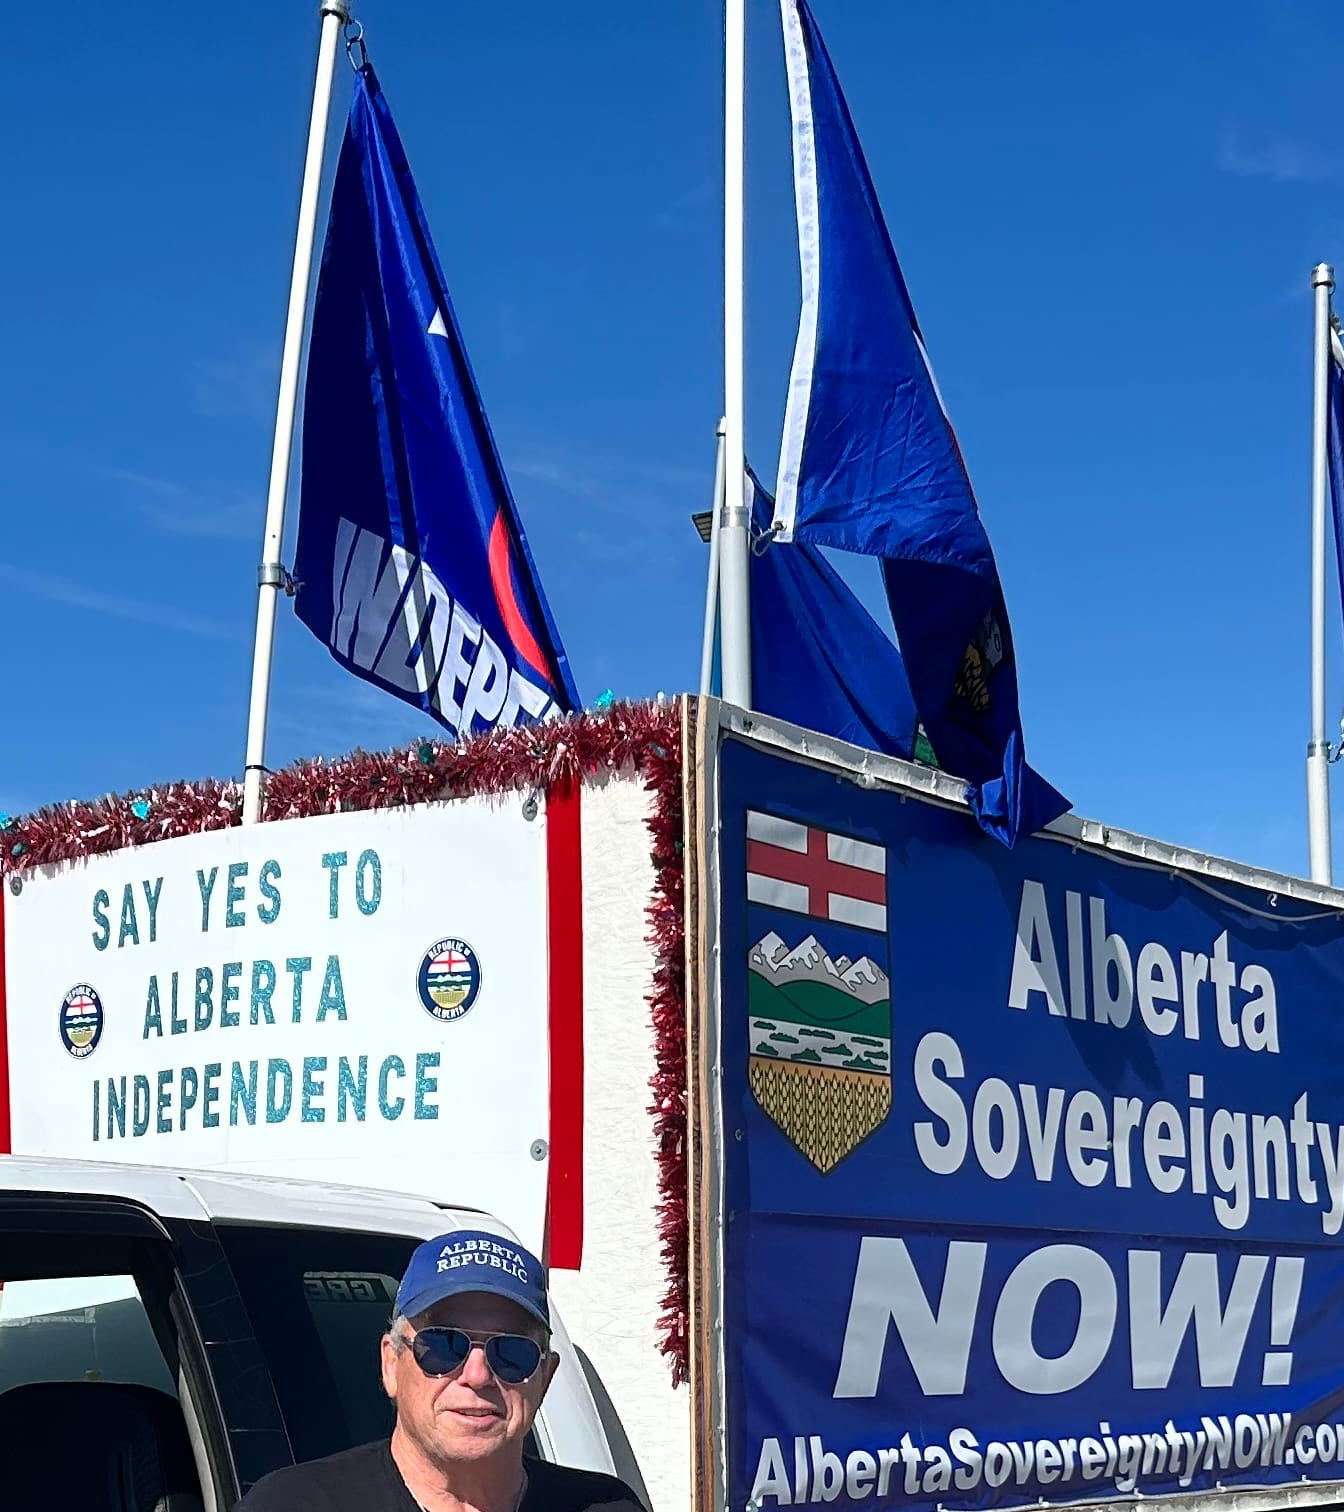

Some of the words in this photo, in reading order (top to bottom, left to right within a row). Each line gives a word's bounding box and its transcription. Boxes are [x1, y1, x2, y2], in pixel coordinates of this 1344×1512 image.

[92, 877, 164, 951] SAY
[197, 860, 281, 932] YES
[322, 849, 382, 919] TO
[143, 955, 348, 1039] ALBERTA
[1008, 879, 1279, 1055] Alberta
[92, 1052, 441, 1142] INDEPENDENCE
[436, 1253, 528, 1284] REPUBLIC
[439, 1239, 526, 1268] ALBERTA
[833, 1236, 1306, 1400] NOW!
